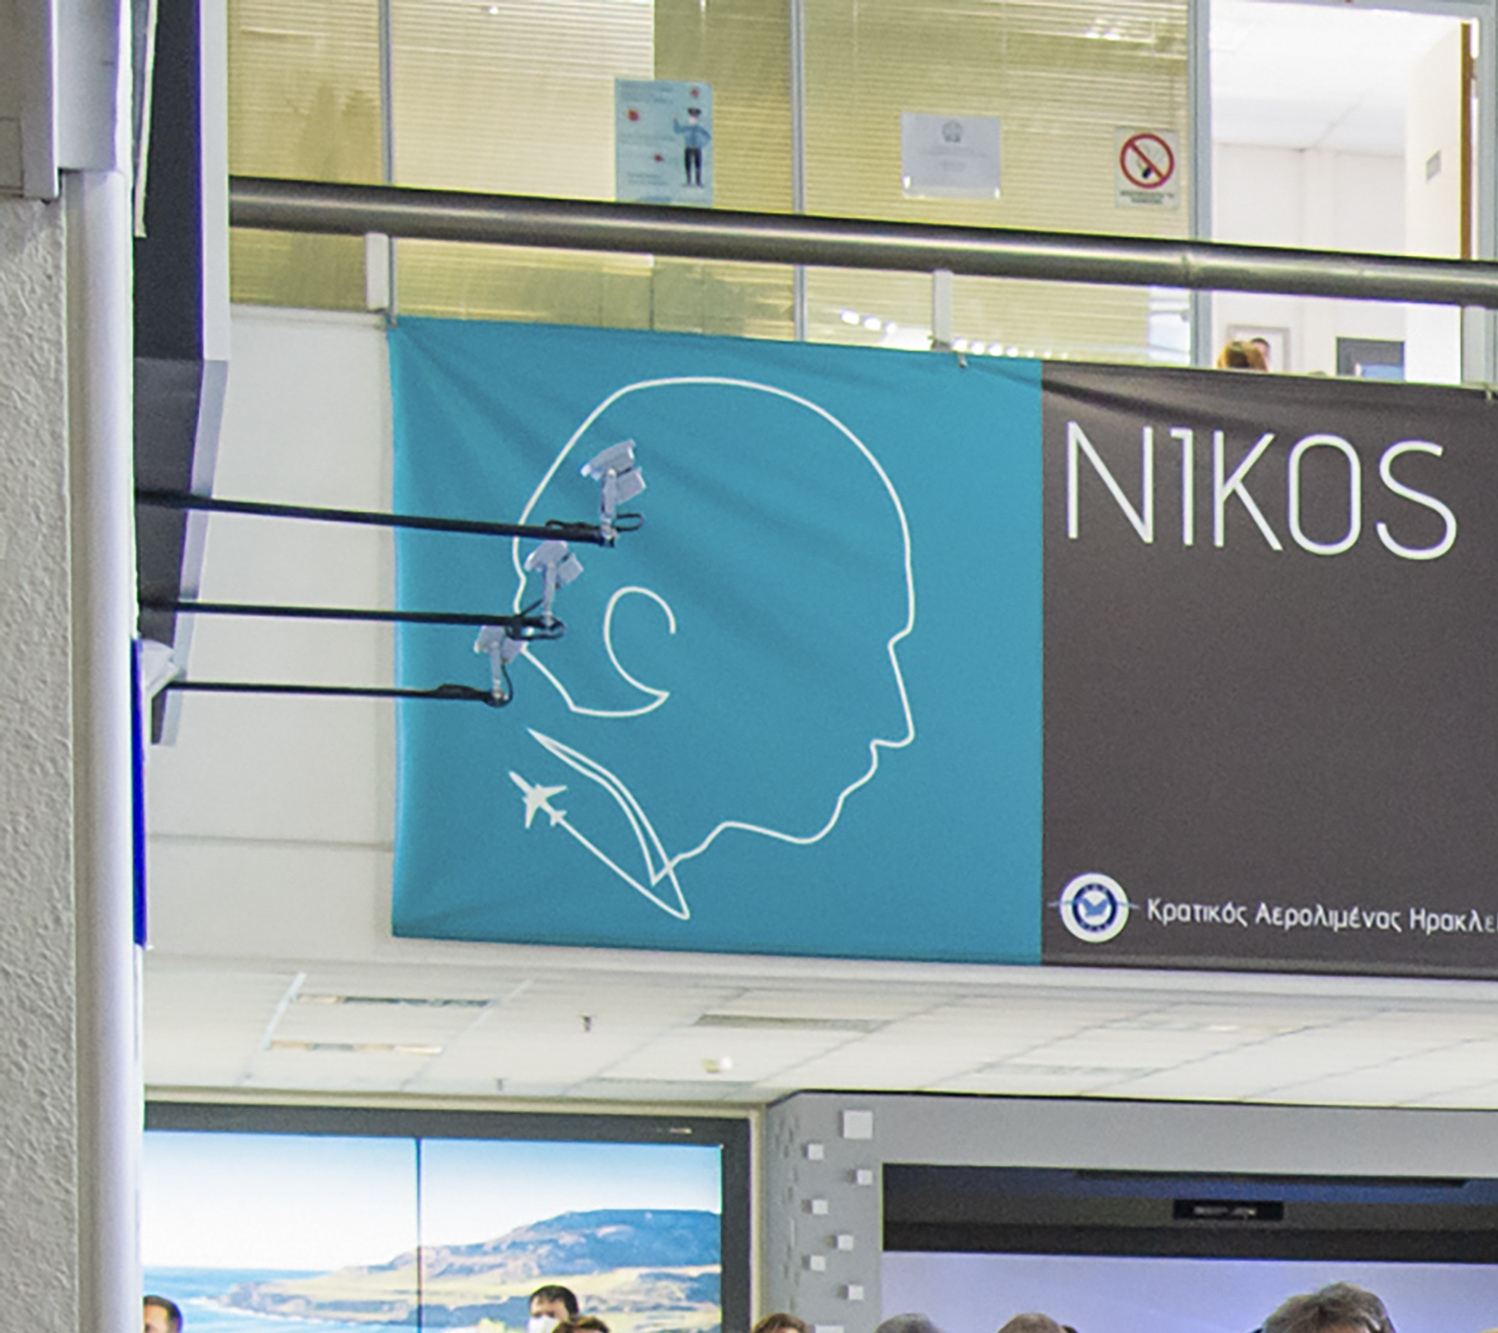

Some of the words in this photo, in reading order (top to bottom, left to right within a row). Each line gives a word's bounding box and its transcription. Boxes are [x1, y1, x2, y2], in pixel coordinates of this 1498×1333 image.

[1066, 420, 1460, 562] NIKOS
[1147, 898, 1248, 928] Κρατικός
[1255, 902, 1402, 932] Αερολιμένας
